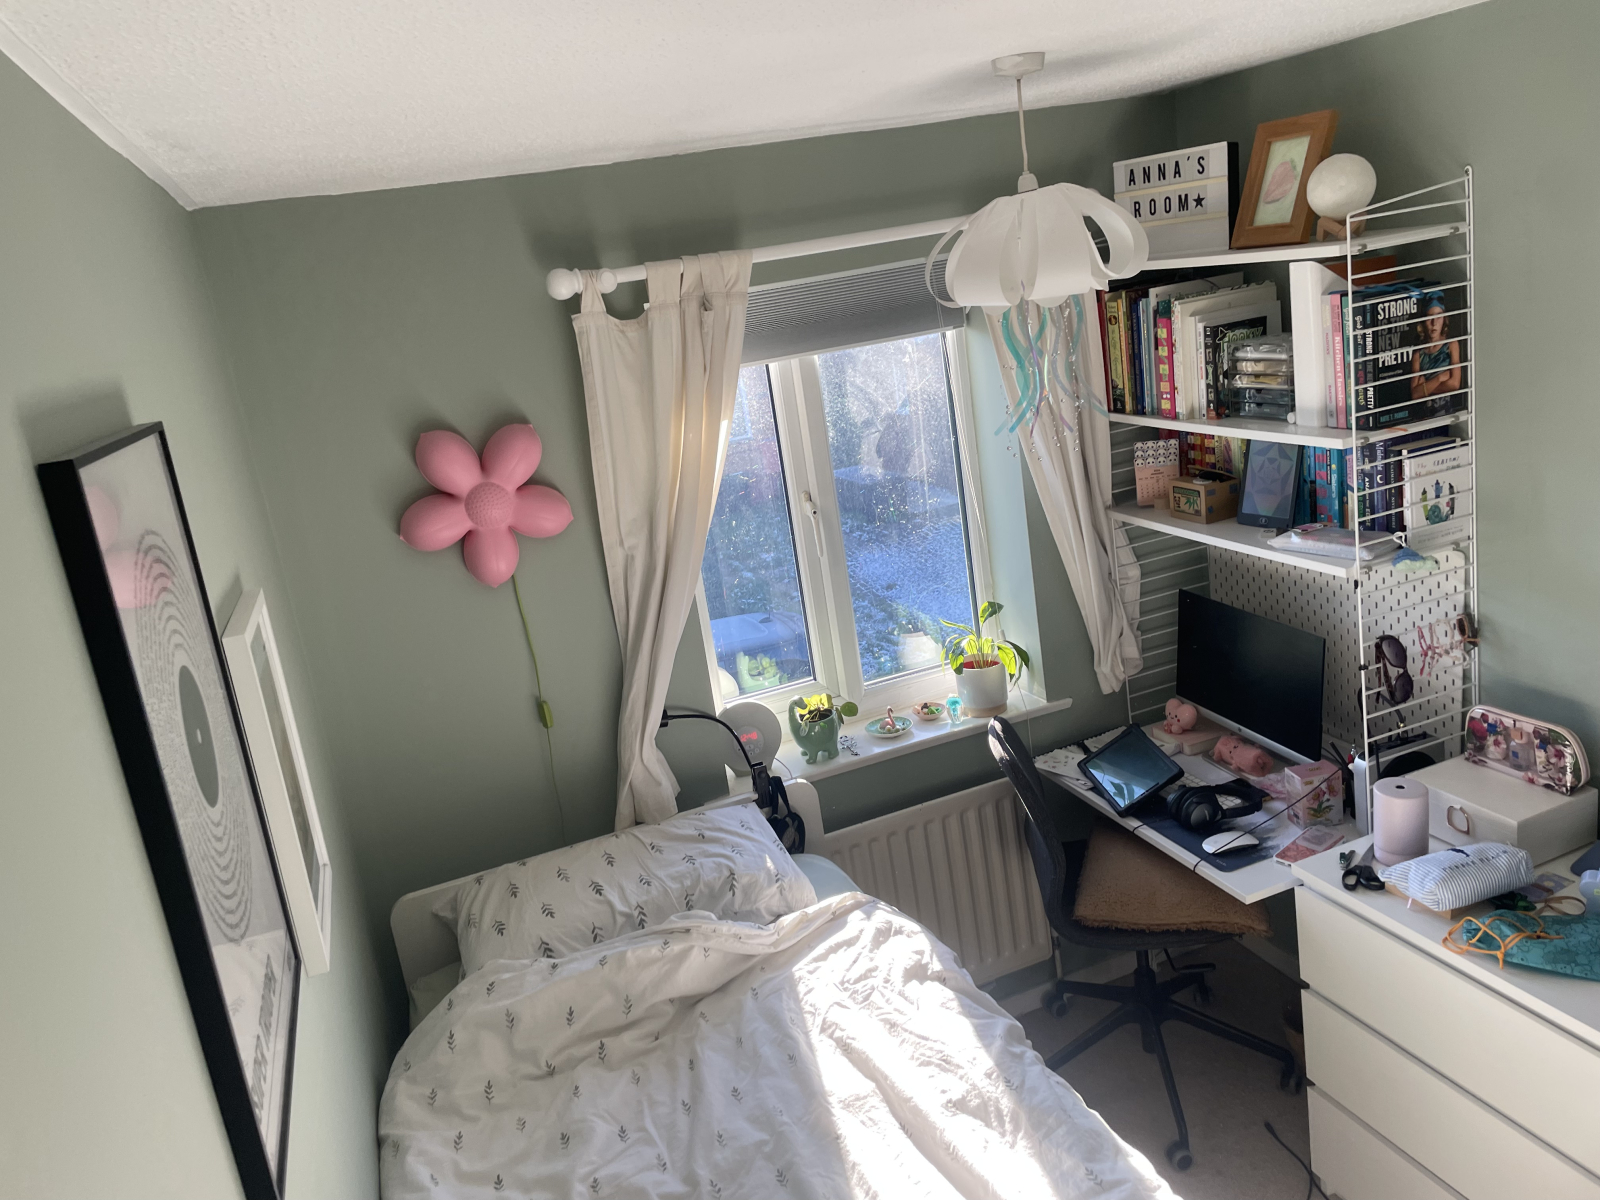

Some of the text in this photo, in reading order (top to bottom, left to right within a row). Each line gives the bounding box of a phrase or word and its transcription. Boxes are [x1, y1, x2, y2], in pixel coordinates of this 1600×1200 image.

[1128, 156, 1205, 186] ANNA'S
[1133, 193, 1189, 218] ROOM
[1377, 297, 1417, 320] STRONG
[1378, 332, 1400, 351] NEW
[1378, 345, 1414, 368] PRETTY
